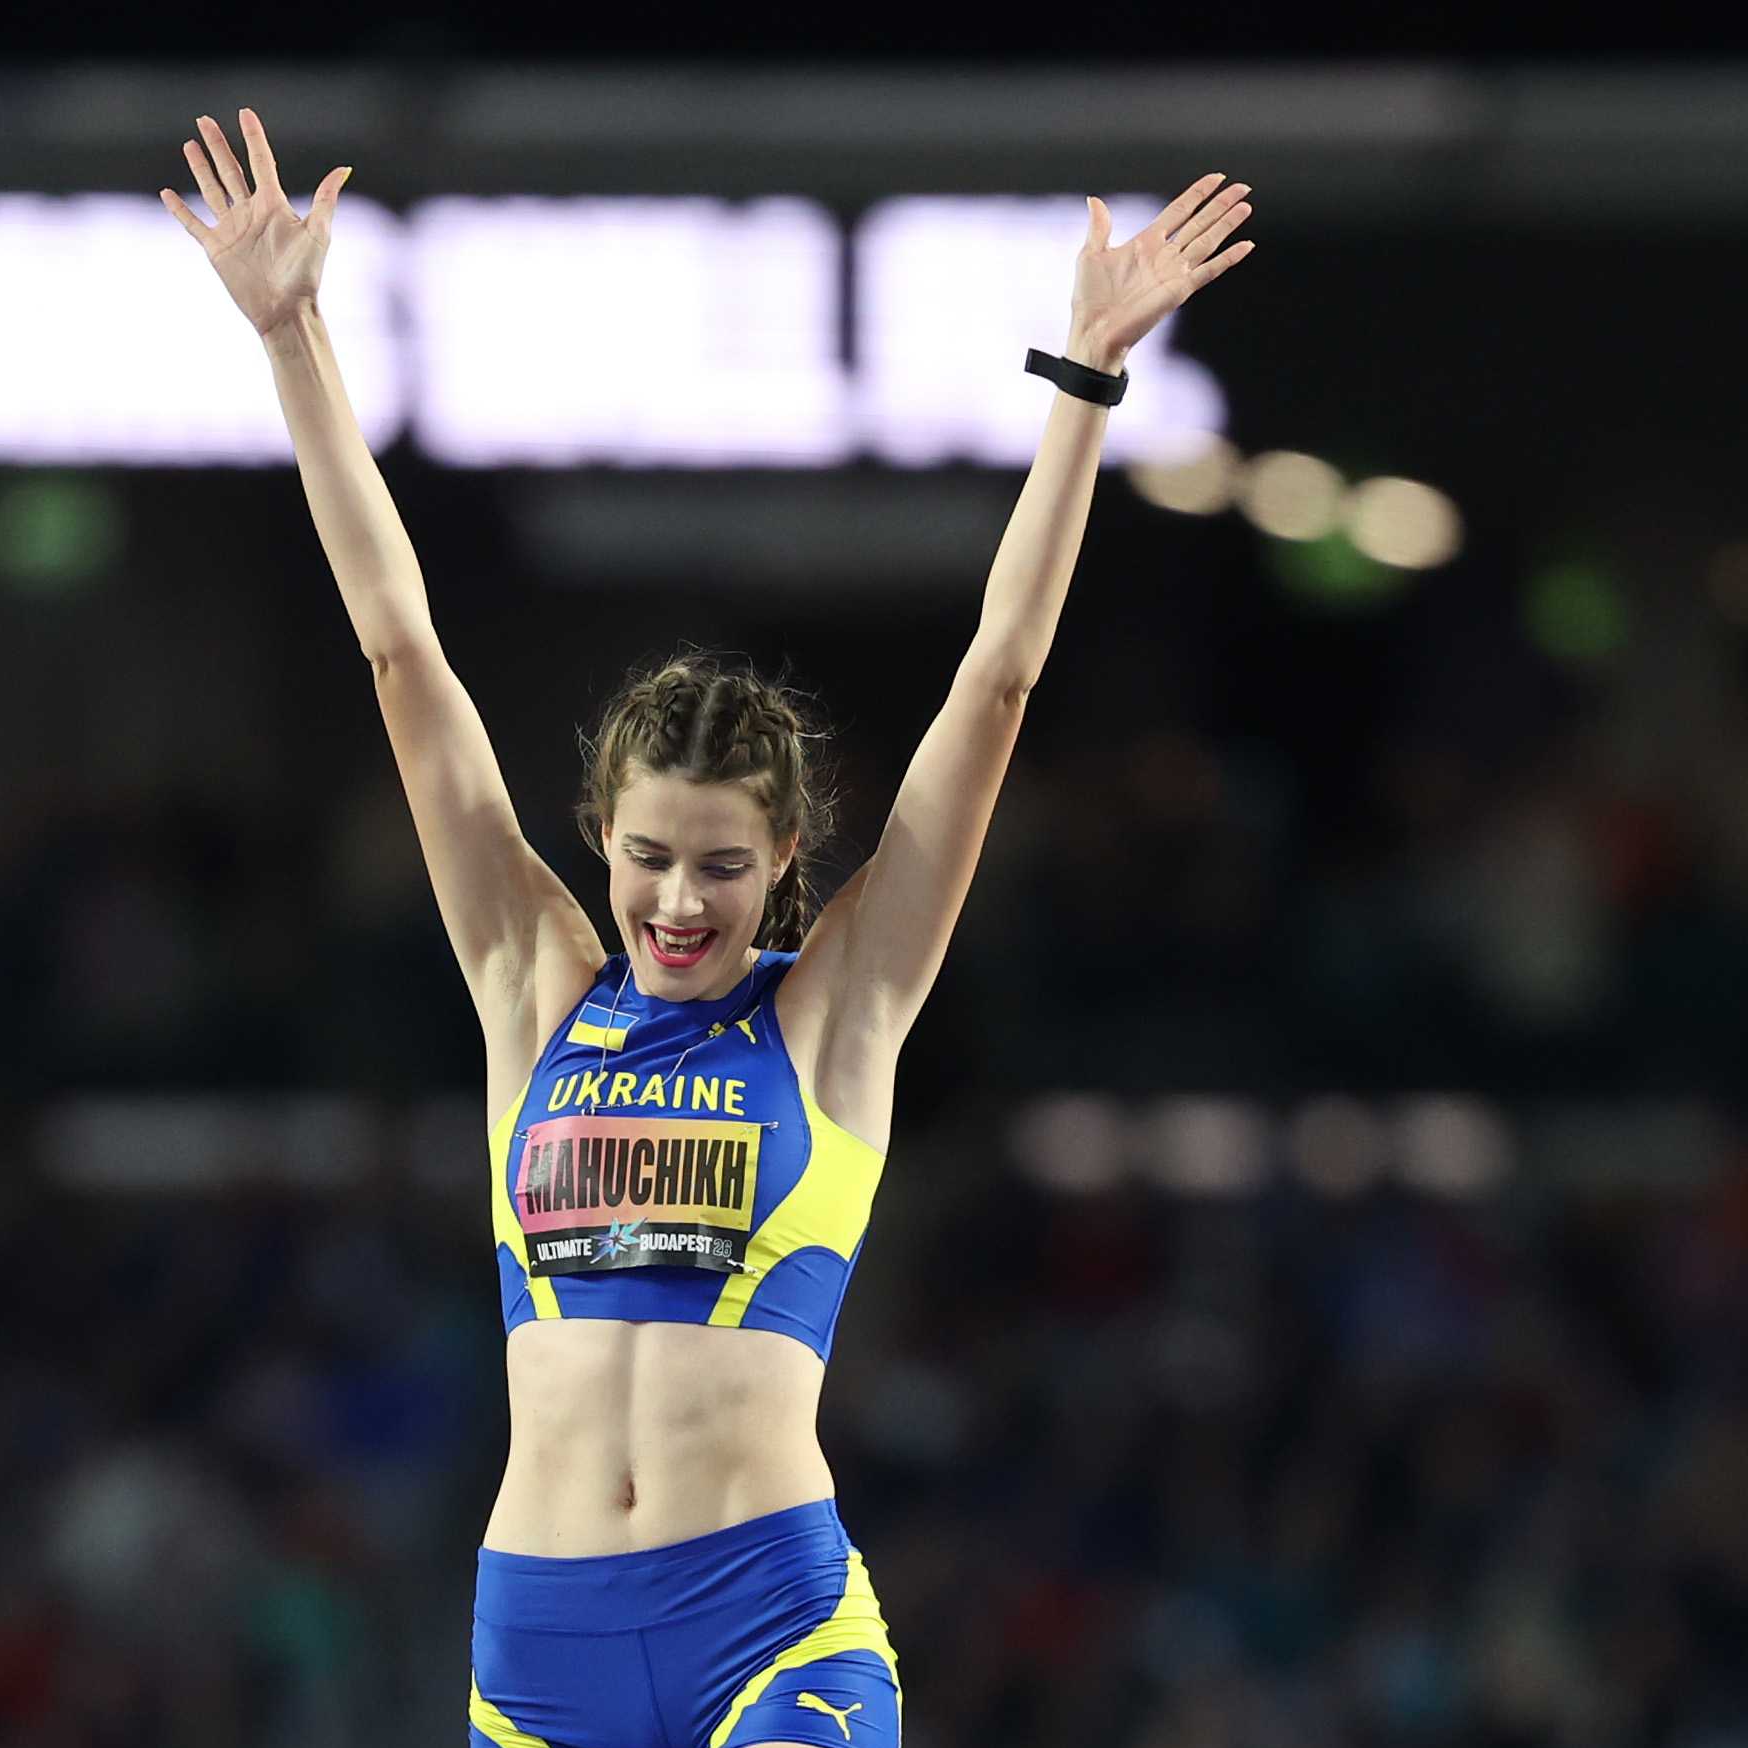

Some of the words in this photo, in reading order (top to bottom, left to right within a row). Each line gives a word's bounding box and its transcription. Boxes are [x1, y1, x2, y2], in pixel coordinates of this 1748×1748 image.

[548, 1070, 747, 1116] UKRAINE
[525, 1136, 749, 1215] MAHUCHIKH
[536, 1237, 593, 1262] ULTIMATE
[639, 1232, 713, 1256] BUDAPEST
[712, 1238, 733, 1258] 26
